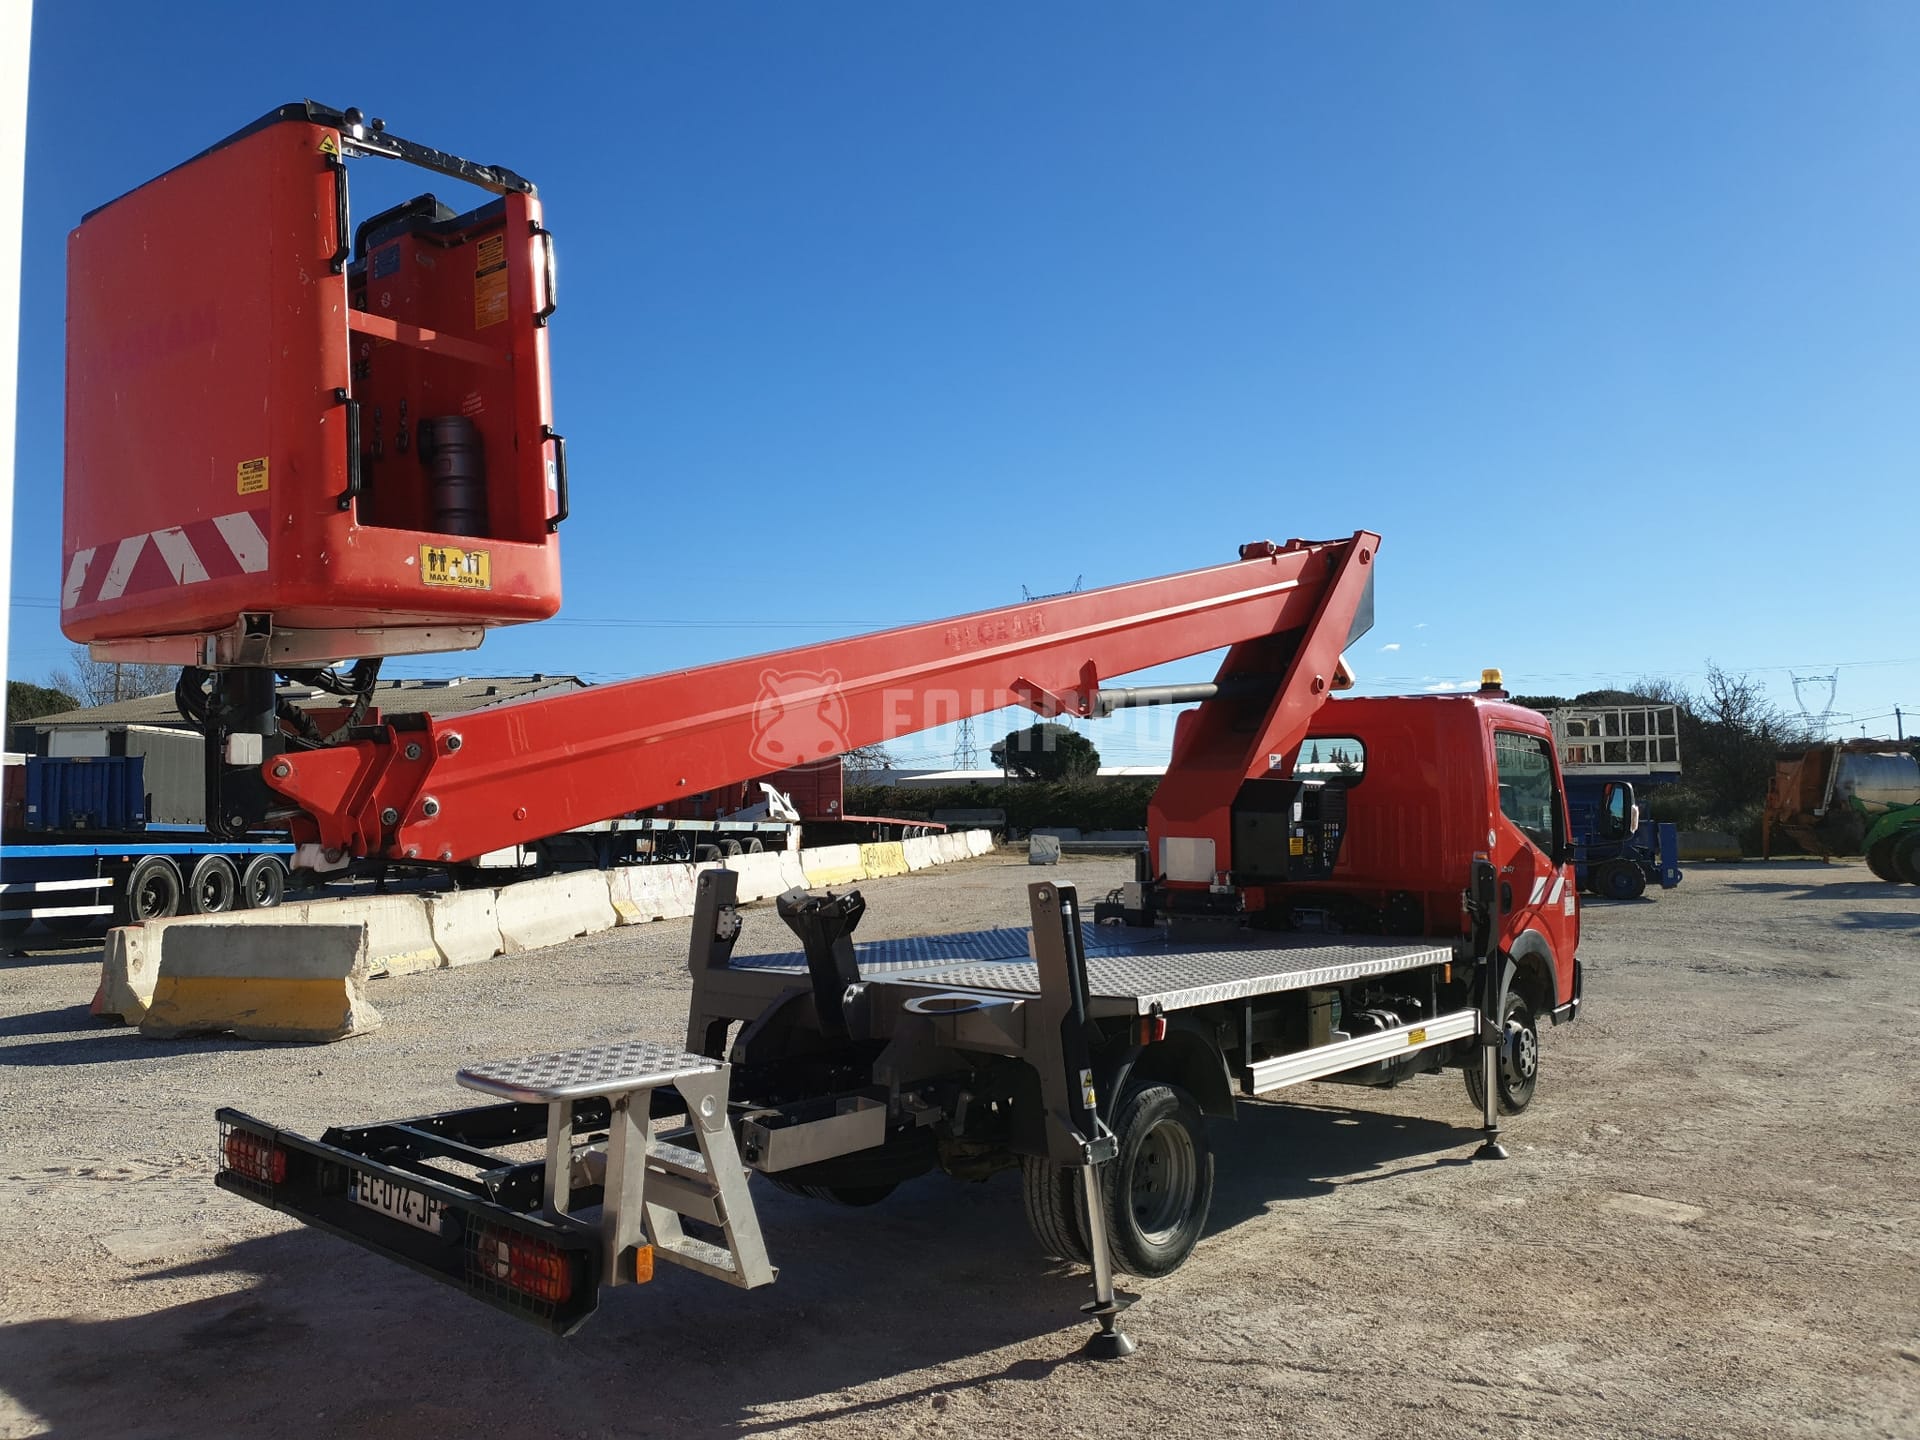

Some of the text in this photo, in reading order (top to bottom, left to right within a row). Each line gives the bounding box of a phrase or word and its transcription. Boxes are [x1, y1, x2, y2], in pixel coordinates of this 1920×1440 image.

[429, 573, 448, 582] MAX
[458, 575, 473, 584] 250
[475, 577, 485, 587] kg
